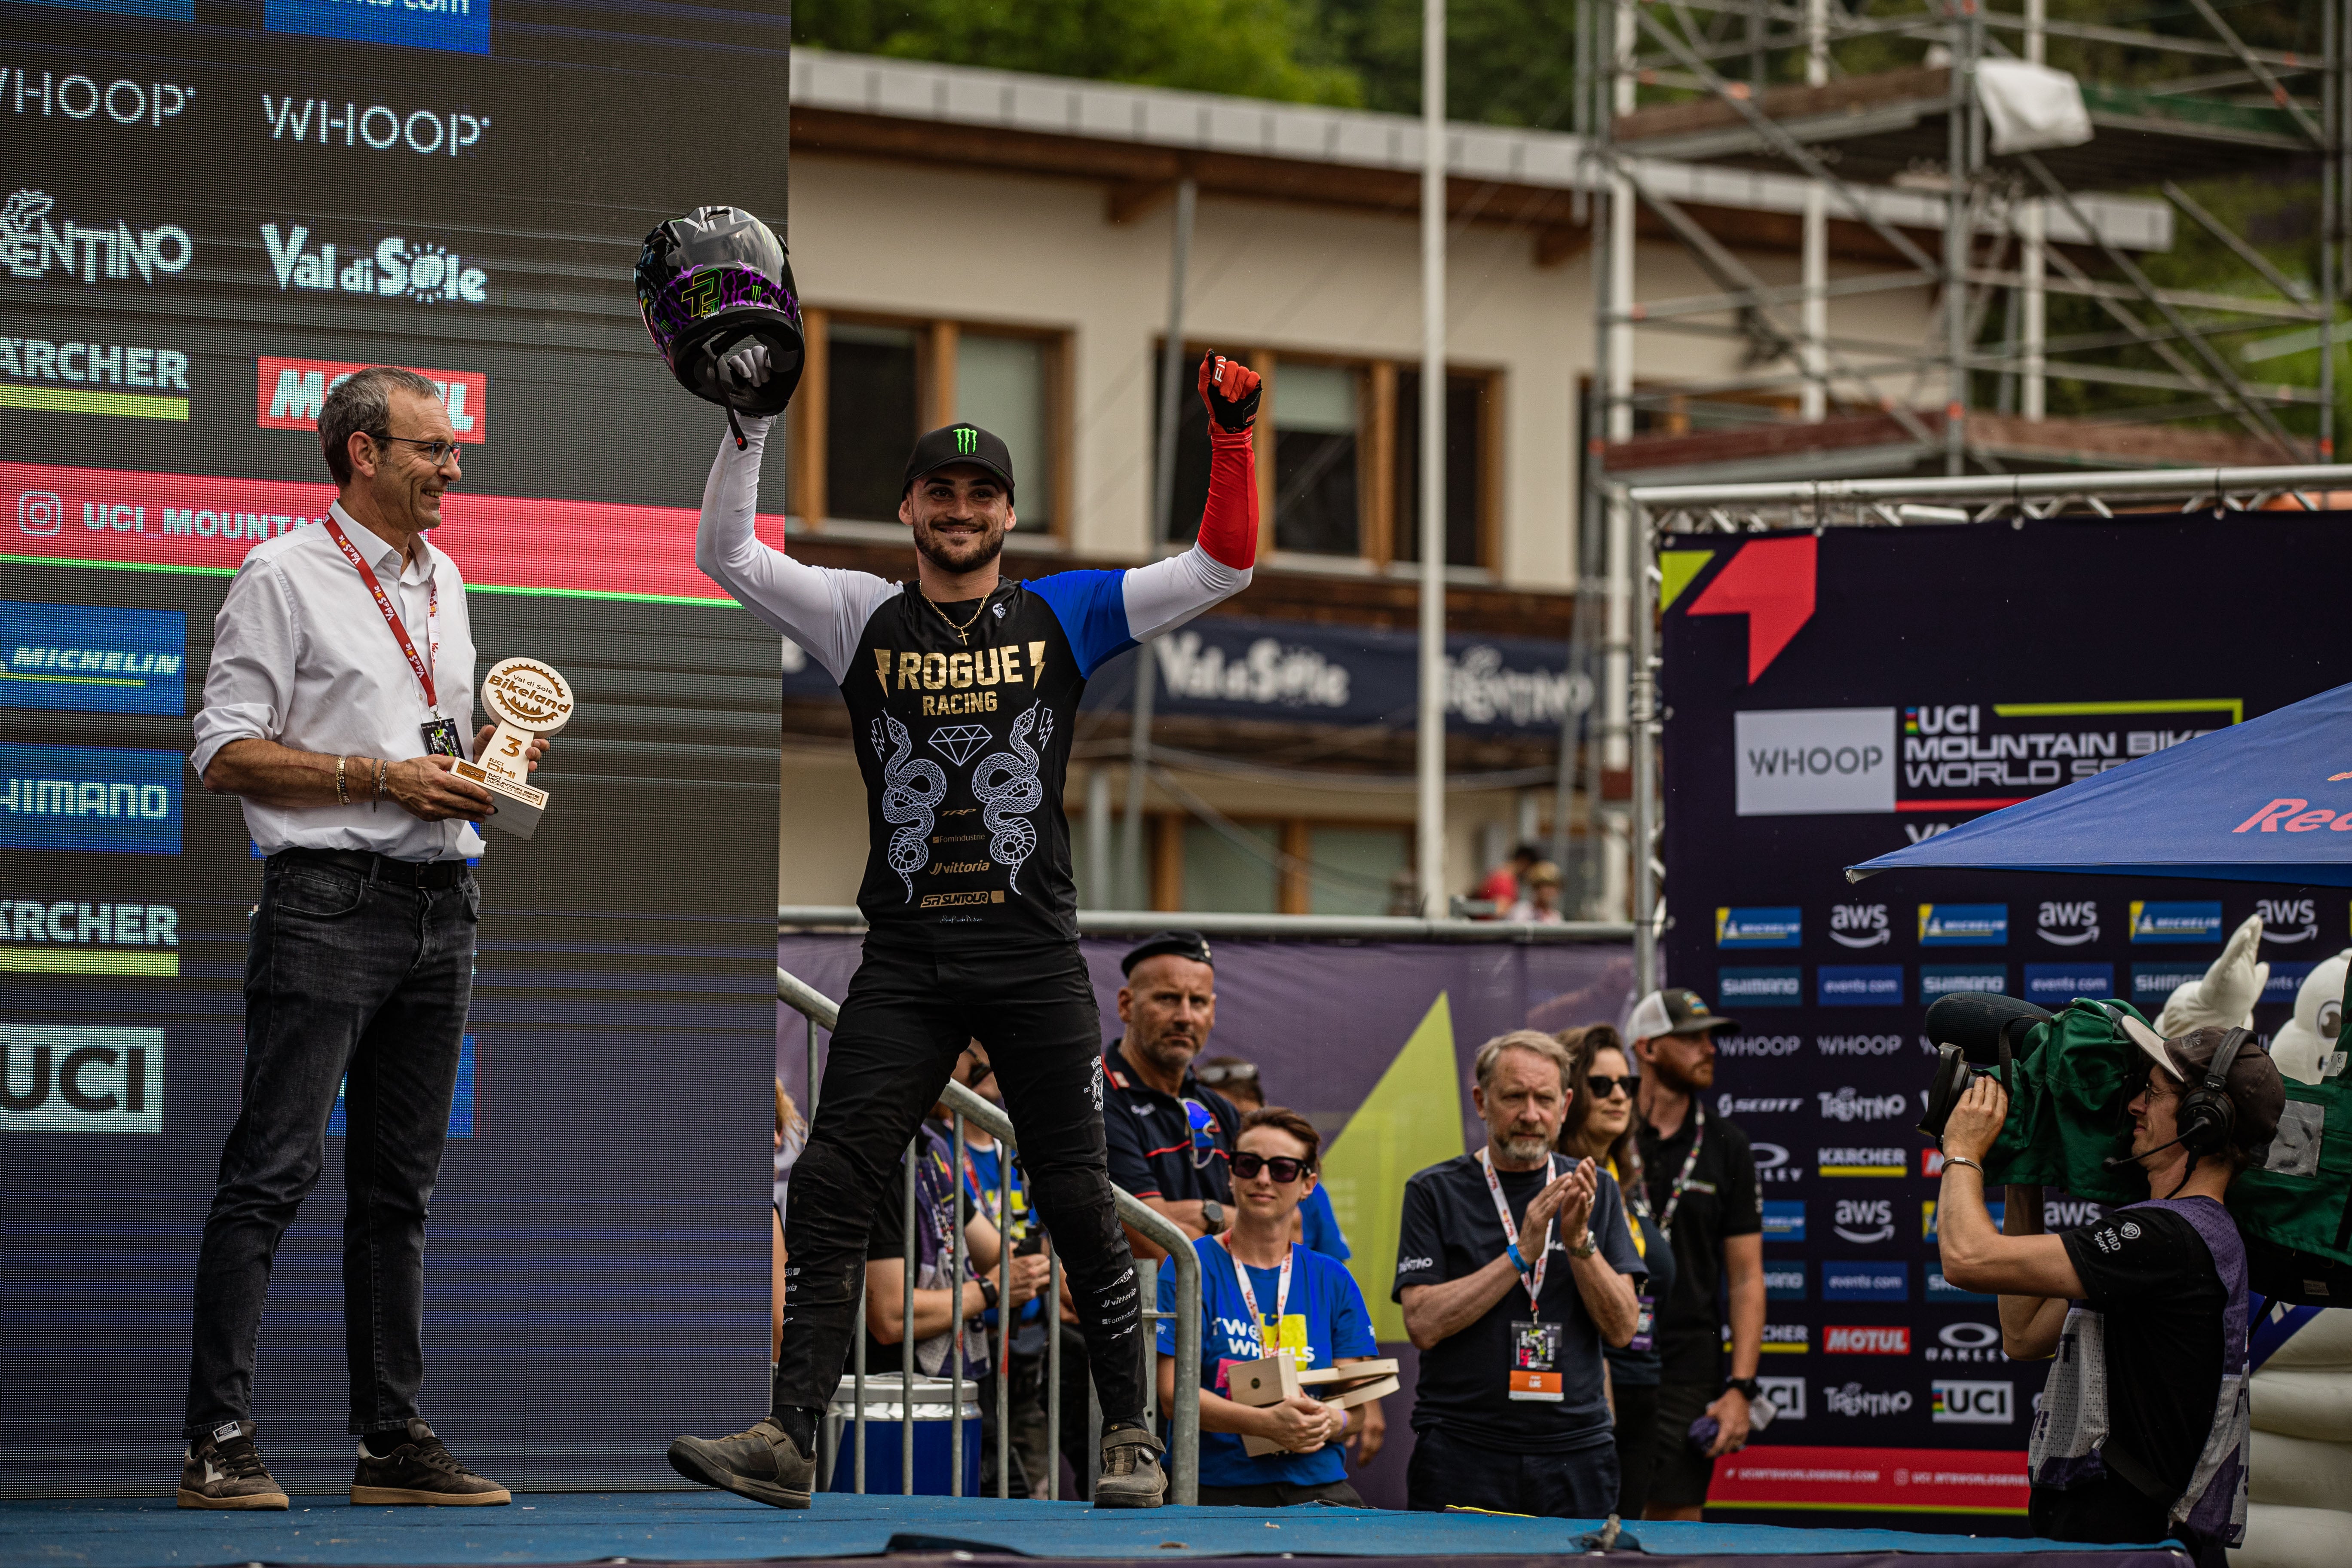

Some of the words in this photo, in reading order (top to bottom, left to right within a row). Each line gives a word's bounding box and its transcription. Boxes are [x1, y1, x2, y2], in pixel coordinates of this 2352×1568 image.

[0, 69, 187, 127] HOOP
[263, 94, 481, 156] WHOOP
[260, 224, 334, 290] Val
[340, 254, 374, 292] di
[376, 237, 487, 302] Sole
[83, 502, 322, 542] UCI_MOUNT
[374, 585, 387, 603] Sole
[385, 606, 395, 621] Val
[12, 646, 181, 675] MICHELIN
[405, 643, 417, 662] Sole
[415, 665, 426, 678] Val
[897, 645, 1023, 690] ROGUE
[488, 675, 571, 714] Bikeland
[514, 675, 525, 683] Val
[536, 684, 553, 694] Sole
[922, 691, 998, 716] RACING
[1918, 705, 1980, 735] UCI
[500, 735, 523, 757] 3
[1904, 732, 2117, 762] MOUNTAIN
[2127, 730, 2218, 756] BIK
[459, 766, 484, 778] WHOOP
[487, 762, 516, 779] DHI
[492, 758, 504, 766] UCI
[1748, 746, 1883, 778] WHOOP
[1905, 759, 2061, 788] WORLD
[486, 779, 512, 791] WORLD
[514, 790, 539, 802] SERIES
[487, 776, 523, 792] MOUNTAIN
[524, 790, 540, 799] BIKE
[940, 833, 985, 842] FomIndustrie
[943, 860, 990, 873] vittoria
[1830, 903, 1889, 930] aws
[2038, 901, 2098, 927] aws
[2257, 899, 2316, 925] aws
[2135, 974, 2204, 991] SHIM
[1718, 1035, 1801, 1057] WHOOP
[1817, 1035, 1902, 1057] WHOOP
[0, 1042, 145, 1113] UCI
[1734, 1098, 1804, 1112] SCOTT
[1817, 1091, 1907, 1122] TRENTINO
[1764, 1168, 1803, 1182] LEY
[1834, 1199, 1892, 1225] aws
[2045, 1202, 2102, 1226] aws
[2094, 1231, 2110, 1254] Sports
[2104, 1228, 2121, 1250] WBD
[1827, 1329, 1905, 1354] MOTUL
[1926, 1347, 2010, 1363] OAKLEY
[1946, 1388, 2007, 1415] UCI
